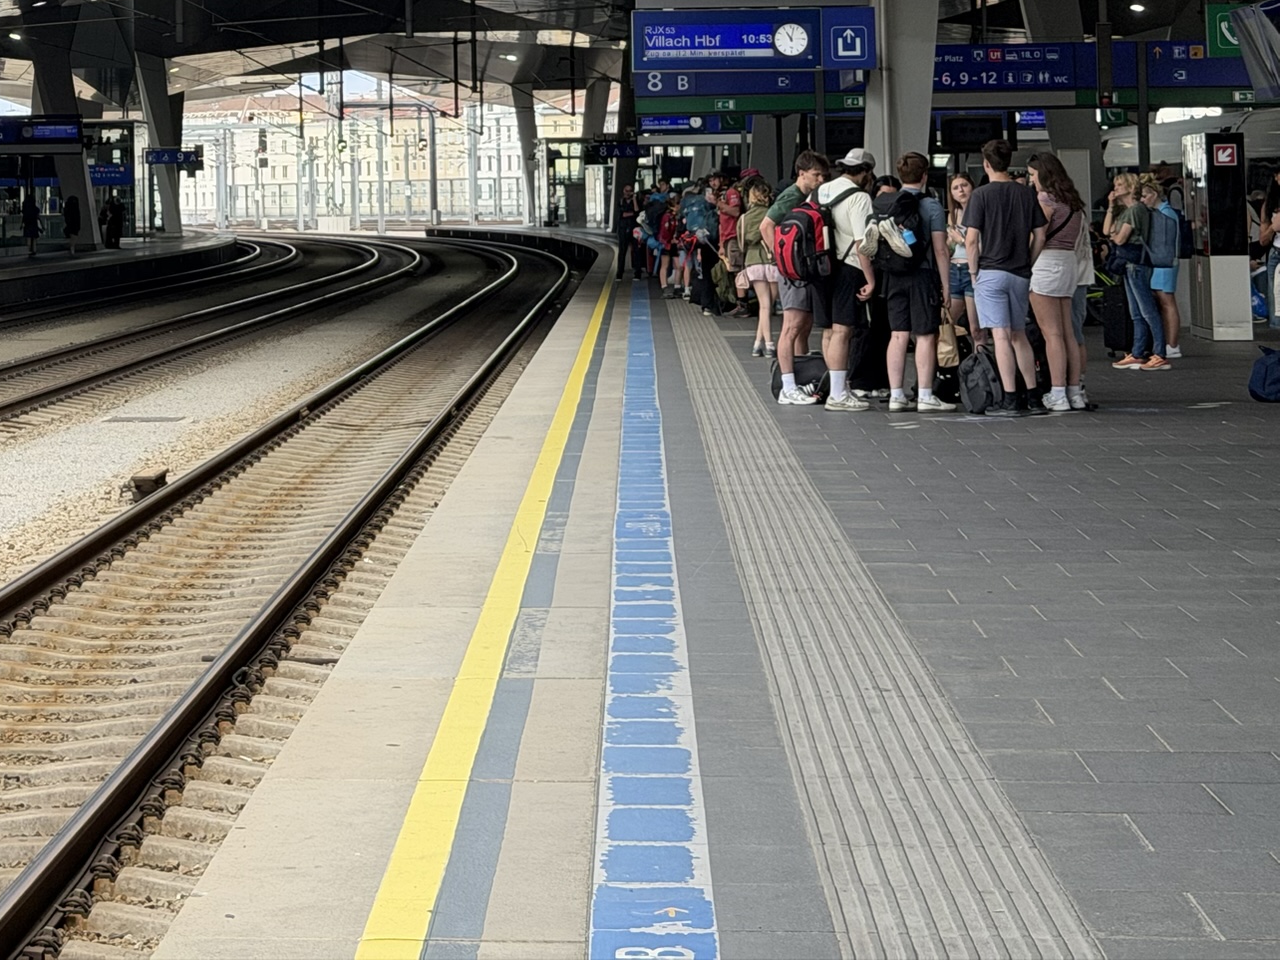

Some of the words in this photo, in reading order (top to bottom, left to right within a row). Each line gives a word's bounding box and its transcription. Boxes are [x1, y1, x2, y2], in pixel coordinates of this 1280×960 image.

[645, 35, 690, 47] Villach
[695, 35, 721, 47] Hbf
[741, 34, 773, 43] 10:53
[647, 72, 662, 91] 8
[677, 76, 689, 90] B
[177, 152, 184, 162] 9
[599, 146, 607, 157] 8
